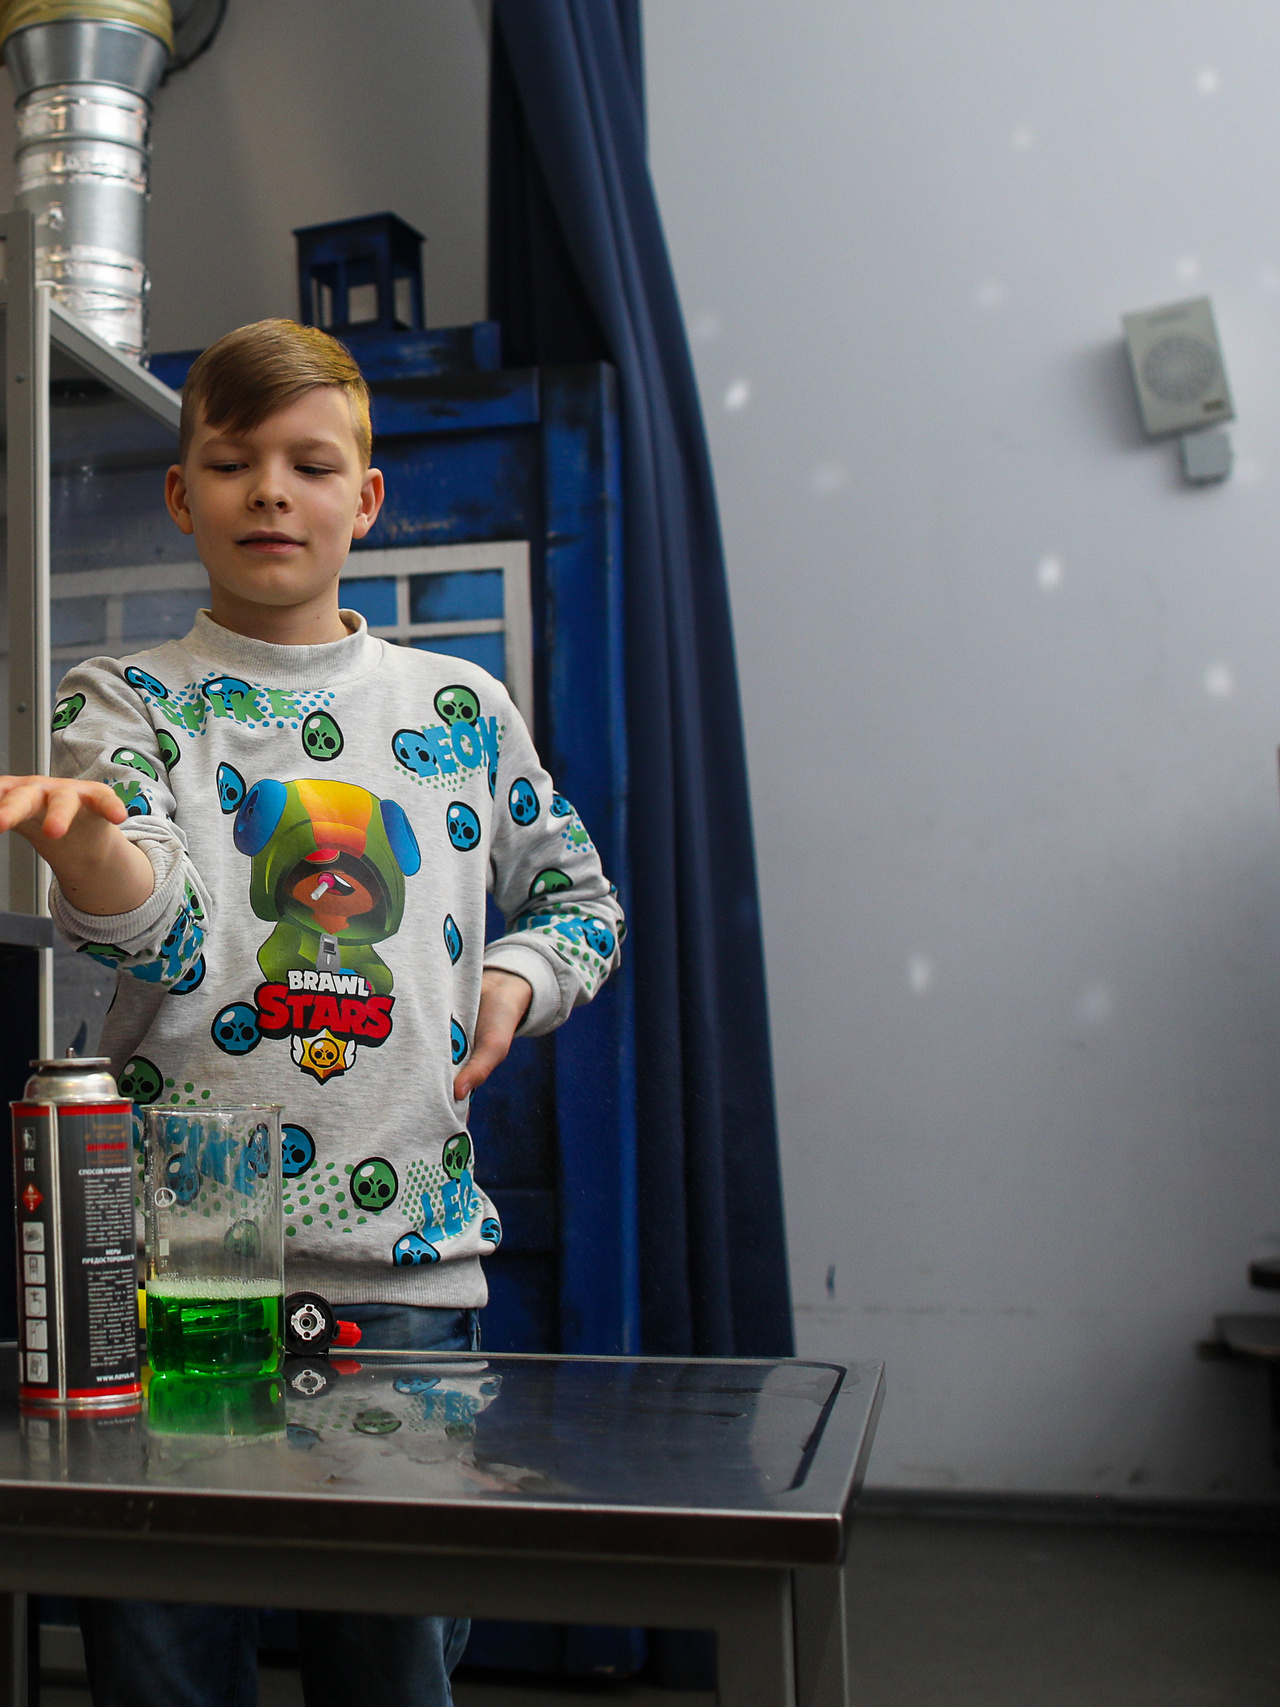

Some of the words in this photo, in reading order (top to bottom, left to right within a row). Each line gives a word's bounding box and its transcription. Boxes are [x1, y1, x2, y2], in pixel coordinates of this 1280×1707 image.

[157, 689, 300, 731] SPIKE
[287, 970, 370, 997] BRAWL
[257, 984, 394, 1039] STARS
